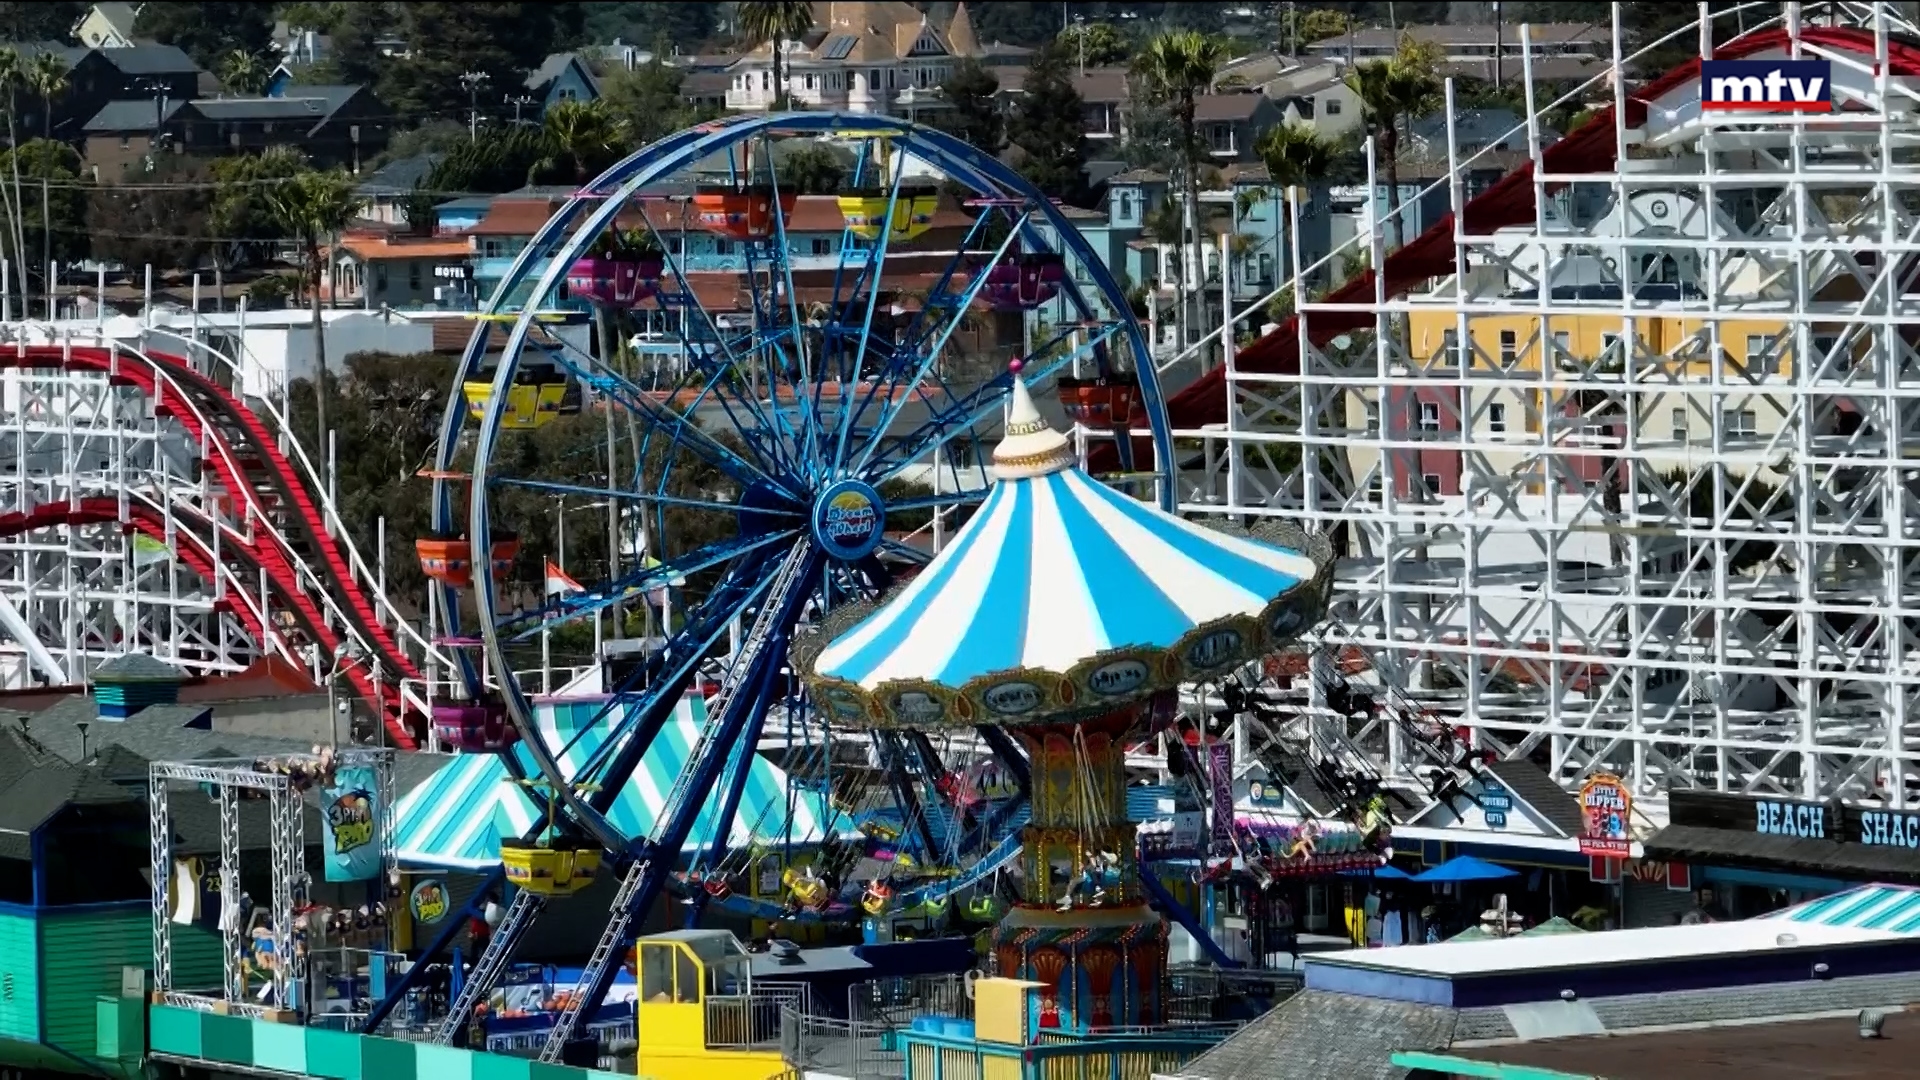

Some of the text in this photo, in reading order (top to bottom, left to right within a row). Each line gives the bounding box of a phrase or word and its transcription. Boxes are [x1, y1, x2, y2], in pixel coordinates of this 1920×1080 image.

[434, 267, 465, 278] MOTEL
[827, 506, 875, 521] Dream
[827, 519, 872, 541] Wheel
[1585, 795, 1624, 810] DIPPER
[1756, 801, 1920, 848] BEACH SHAC
[206, 876, 222, 893] 23
